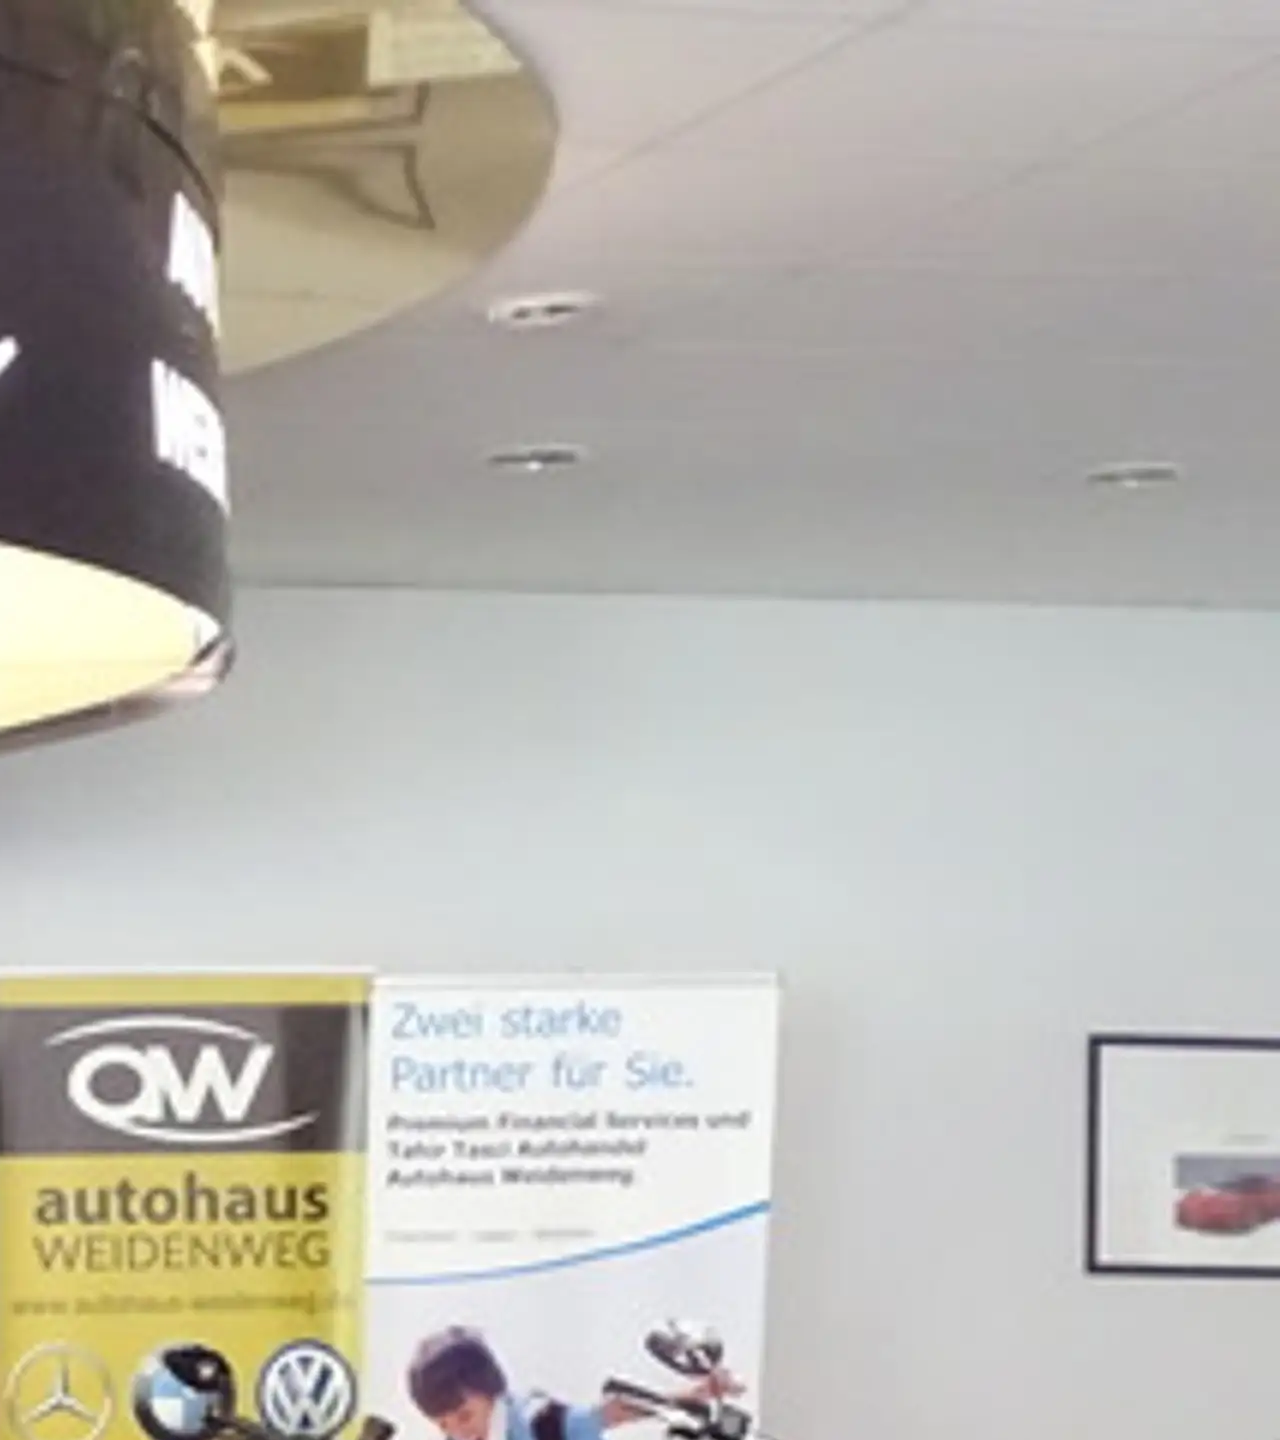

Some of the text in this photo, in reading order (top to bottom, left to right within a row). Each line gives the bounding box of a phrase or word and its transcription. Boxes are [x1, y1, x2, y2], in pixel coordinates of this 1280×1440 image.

[391, 999, 623, 1039] Zwei starke
[390, 1051, 695, 1093] Partner für Sie.
[34, 1171, 330, 1226] autohaus
[32, 1230, 331, 1273] WEIDENWEG
